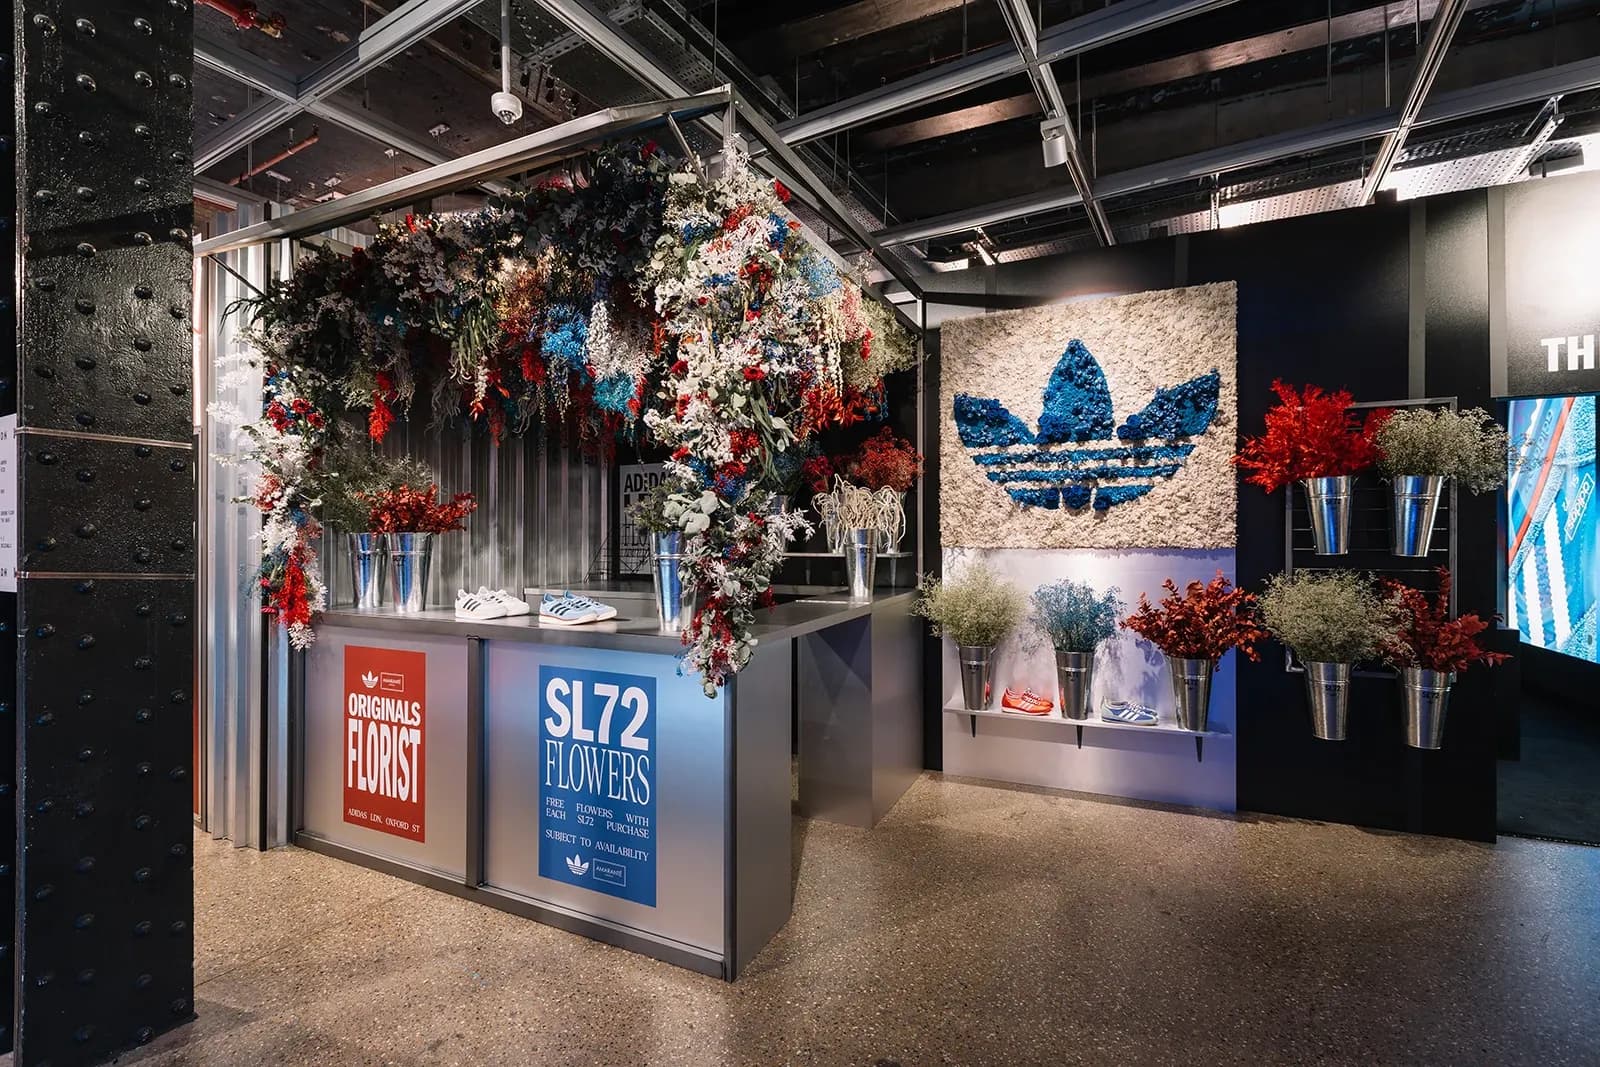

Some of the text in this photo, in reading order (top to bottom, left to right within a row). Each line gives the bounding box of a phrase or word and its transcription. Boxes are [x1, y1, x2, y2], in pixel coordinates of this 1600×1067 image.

[348, 692, 421, 727] ORIGINALS
[544, 677, 649, 751] SL72
[348, 718, 421, 804] FLORIST
[545, 739, 650, 806] FLOWERS
[348, 808, 368, 820] ADIDAS
[385, 817, 409, 831] OXFORD
[412, 824, 421, 833] ST
[546, 796, 649, 827] FREE FLOWERS WITH
[546, 807, 649, 839] EACH SL72 PURCHASE
[545, 829, 649, 862] SUBJECT TO AVAILABILITY
